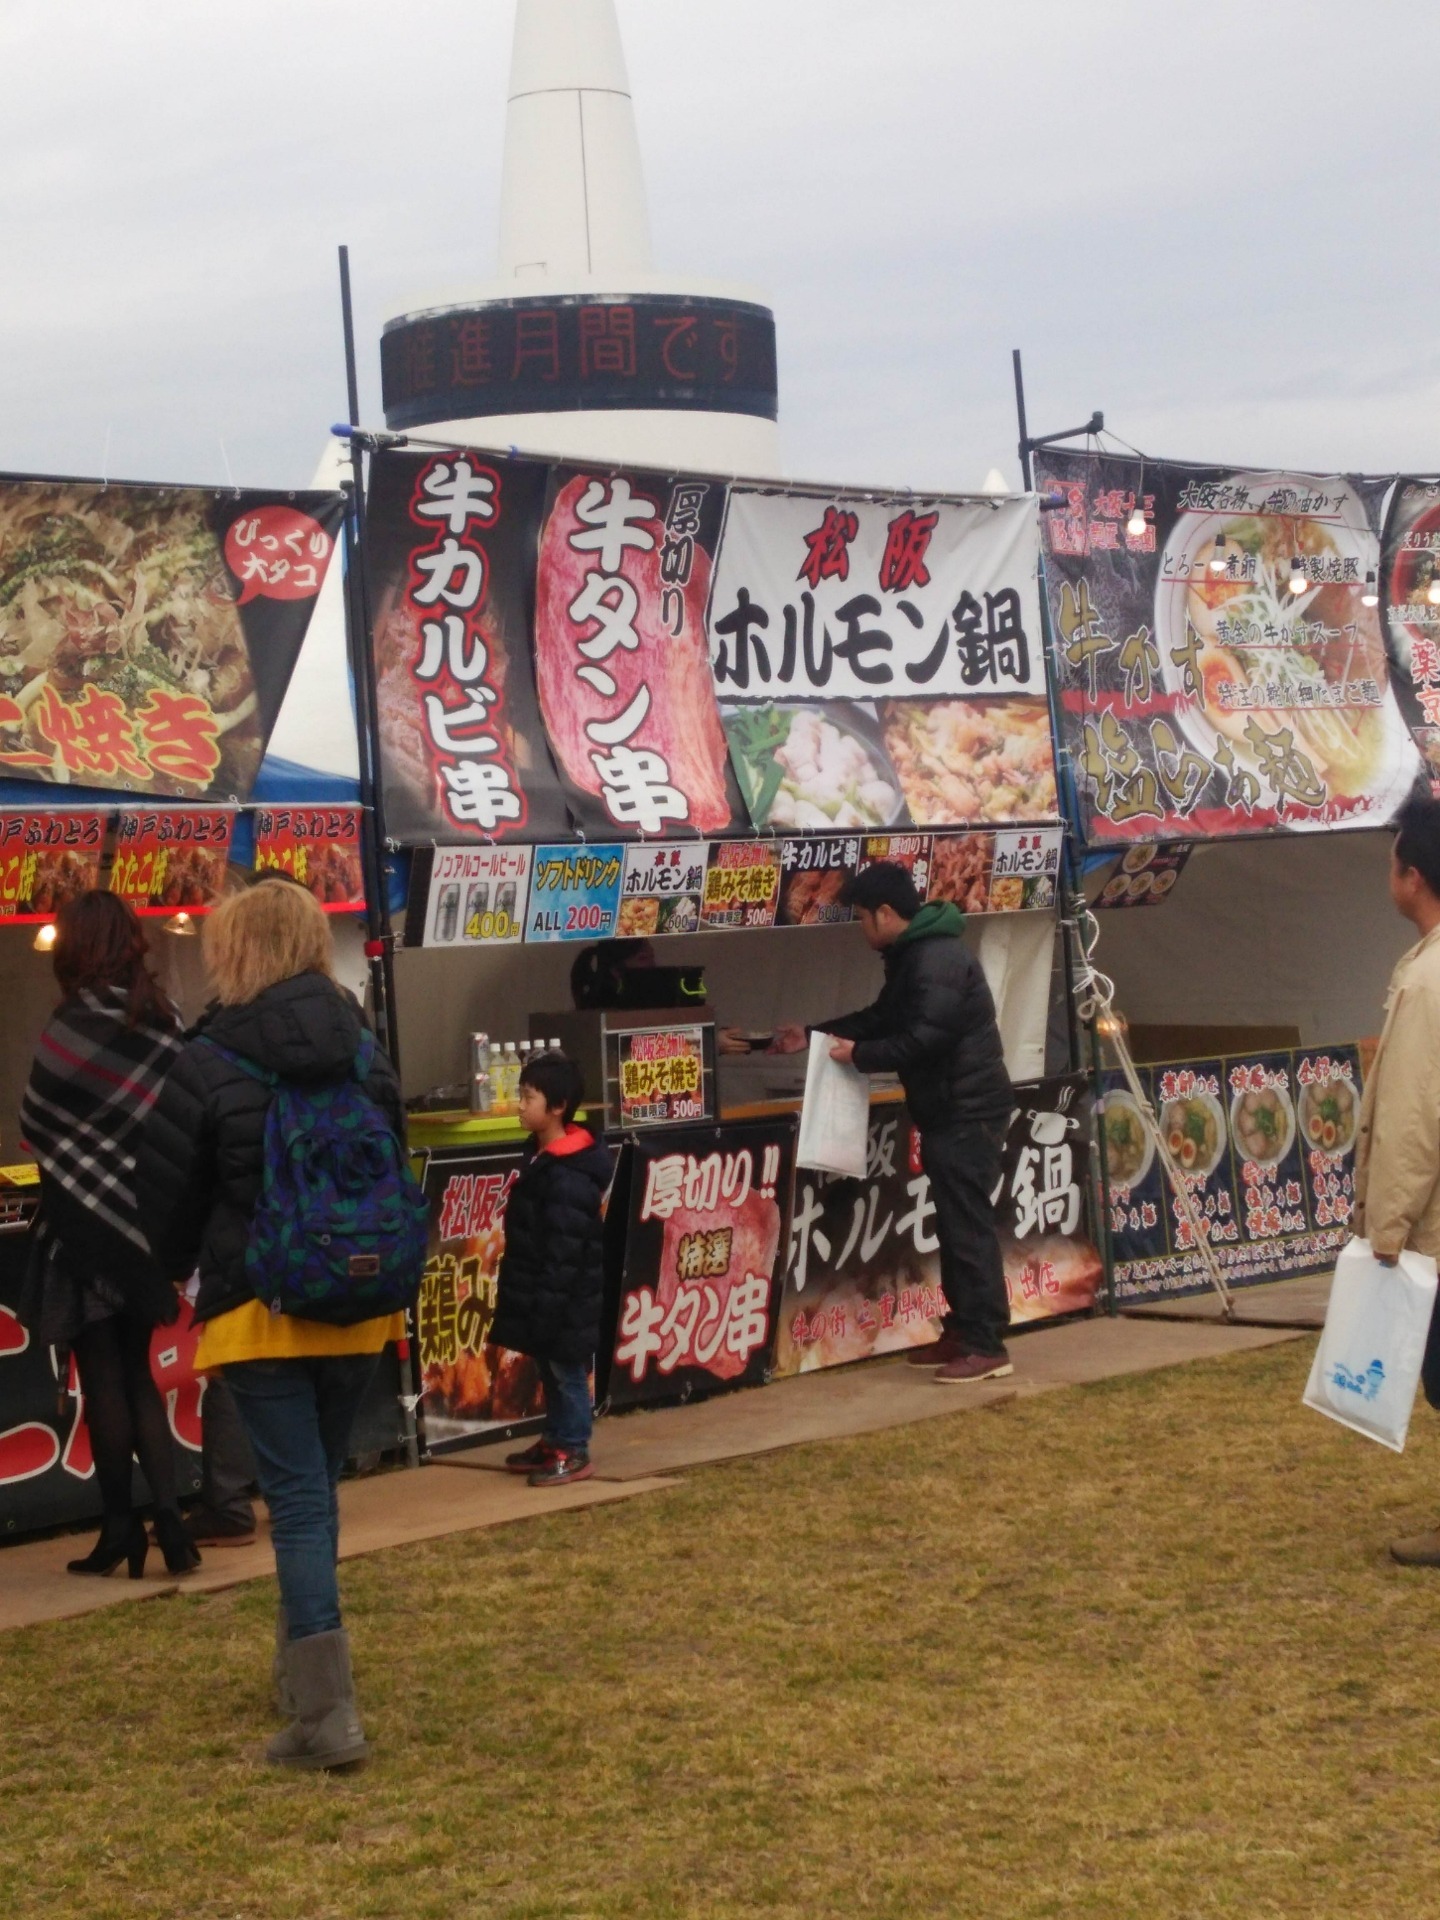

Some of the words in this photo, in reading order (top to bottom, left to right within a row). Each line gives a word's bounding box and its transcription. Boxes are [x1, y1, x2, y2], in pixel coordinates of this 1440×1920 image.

[234, 518, 330, 559] びっくり
[796, 505, 939, 593] 松阪
[242, 552, 318, 588] 大タコ
[661, 484, 708, 637] 厚切り
[1163, 553, 1257, 581] とろー煮卵
[411, 460, 521, 829] 牛カルビ串
[568, 478, 688, 832] 牛タン串
[714, 586, 1031, 690] ホルモン鍋
[0, 817, 102, 846] 戸ふわとろ
[119, 813, 230, 844] 神戸ふわとろ
[256, 810, 357, 841] 神戸ふわとろ
[433, 852, 526, 879] ノンアルコールビール
[782, 839, 859, 871] 牛カルビ串
[996, 848, 1057, 872] ホルモン鍋
[536, 856, 623, 892] ソフトドリンク
[626, 866, 702, 893] ホルモン鍋
[706, 866, 776, 902] 鶏みそ焼き
[464, 911, 520, 938] 400円
[534, 912, 560, 932] ALL
[567, 906, 611, 930] 200円
[746, 908, 773, 926] 500円
[623, 1057, 698, 1095] 鶏みそ焼き
[673, 1099, 701, 1119] 500円
[641, 1146, 780, 1221] 厚切り!!
[787, 1144, 1081, 1293] ホルモ鍋
[616, 1273, 770, 1381] 牛タン串
